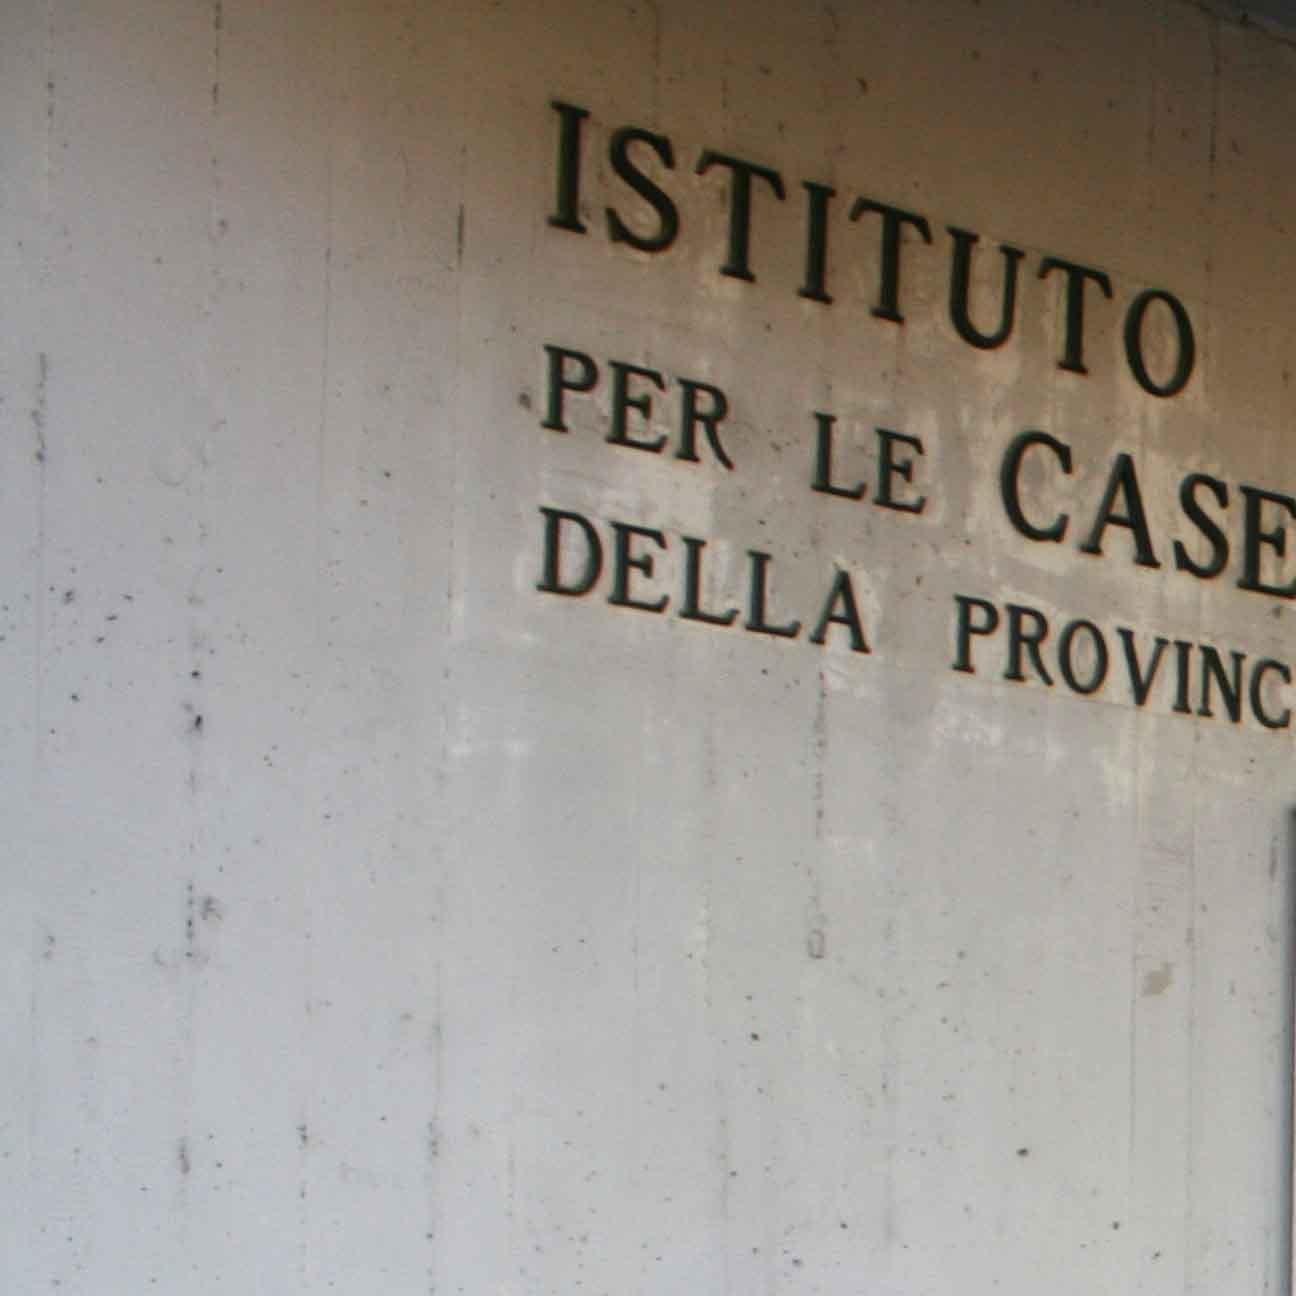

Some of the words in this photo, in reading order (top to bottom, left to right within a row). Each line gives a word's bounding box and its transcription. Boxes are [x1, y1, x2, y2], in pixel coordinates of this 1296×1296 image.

[547, 101, 1196, 398] ISTITUTO
[540, 344, 734, 470] PER
[810, 411, 927, 515] LE
[536, 506, 871, 654] DELLA
